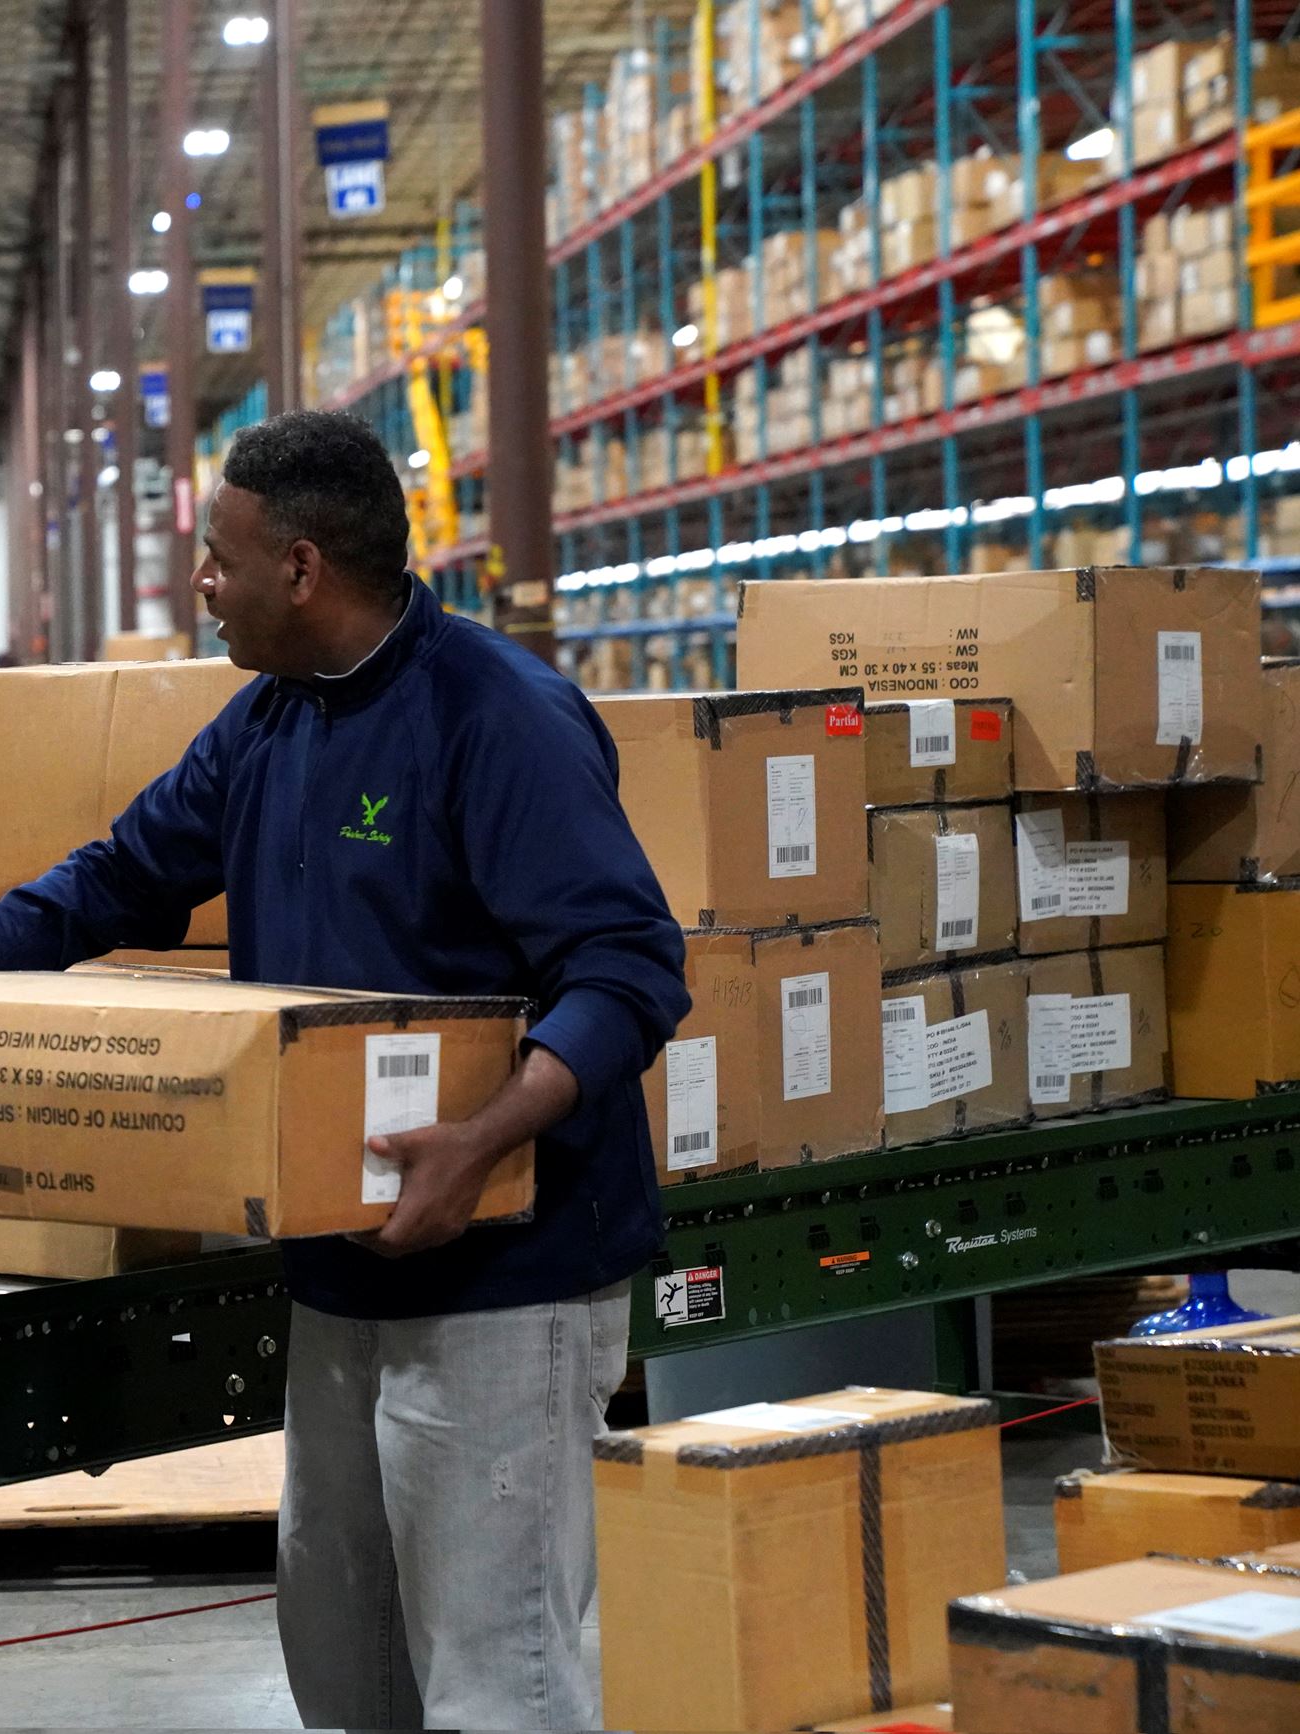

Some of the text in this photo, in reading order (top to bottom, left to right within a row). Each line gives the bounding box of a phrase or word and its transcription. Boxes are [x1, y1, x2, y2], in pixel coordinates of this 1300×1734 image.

[829, 633, 855, 645] KGS
[956, 628, 978, 640] NW
[832, 649, 857, 661] KGS
[956, 644, 978, 656] GW
[840, 665, 857, 676] CM
[864, 664, 878, 675] 30
[892, 663, 907, 675] 40
[922, 662, 935, 674] 55
[946, 661, 978, 672] Meas
[868, 679, 938, 691] INDONESIA
[950, 678, 978, 689] COO
[829, 715, 858, 727] Partial
[38, 1033, 101, 1051] CARTON
[106, 1036, 161, 1056] GROSS
[11, 1068, 22, 1084] X
[25, 1069, 43, 1086] 65
[56, 1071, 153, 1093] DIMENSIONS
[158, 1075, 225, 1097] CARTON
[26, 1106, 79, 1126] ORIGIN
[84, 1110, 105, 1128] OF
[110, 1112, 185, 1133] COUNTRY
[36, 1172, 57, 1190] TO
[60, 1174, 95, 1193] SHIP
[945, 1227, 1037, 1254] Rapistan Systems
[694, 1270, 718, 1281] DANGER
